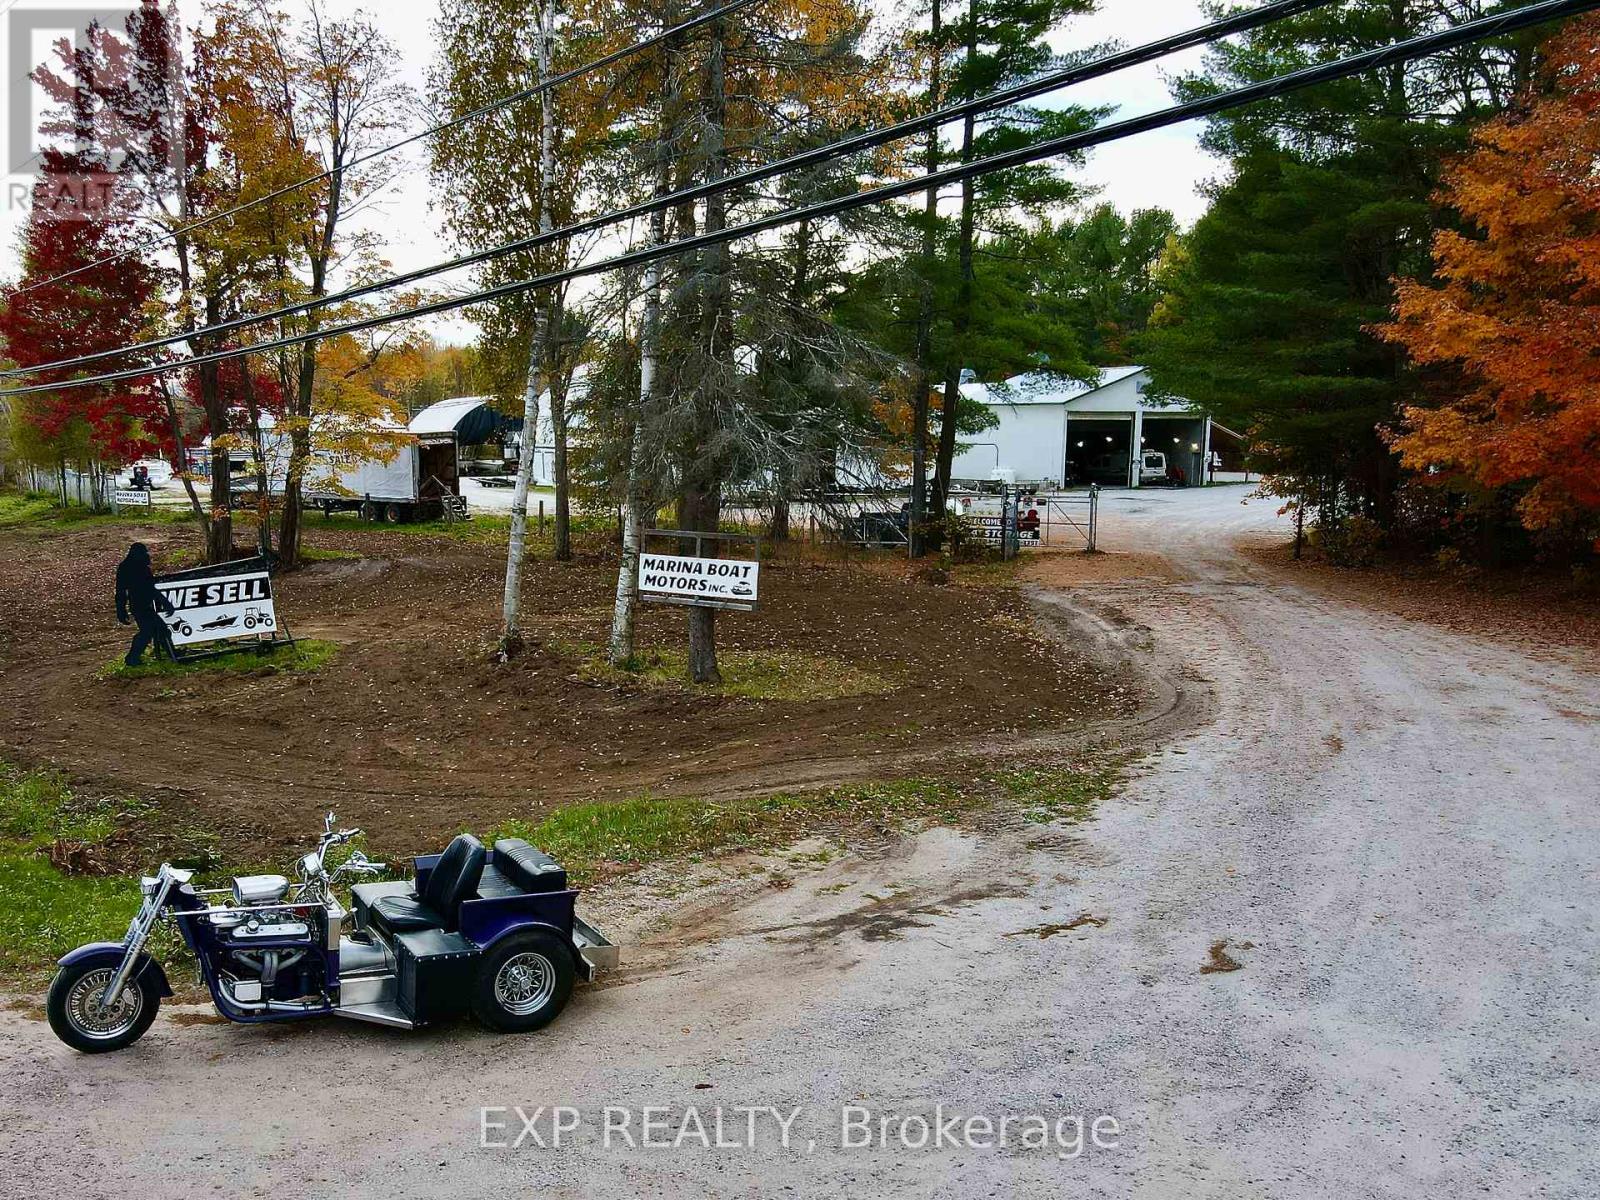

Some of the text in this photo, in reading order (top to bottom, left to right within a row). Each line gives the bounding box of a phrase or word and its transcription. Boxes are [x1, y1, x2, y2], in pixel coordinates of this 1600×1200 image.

[643, 558, 751, 578] MARINA BOAT
[206, 580, 265, 605] SELL
[644, 574, 728, 593] MOTORS INC.
